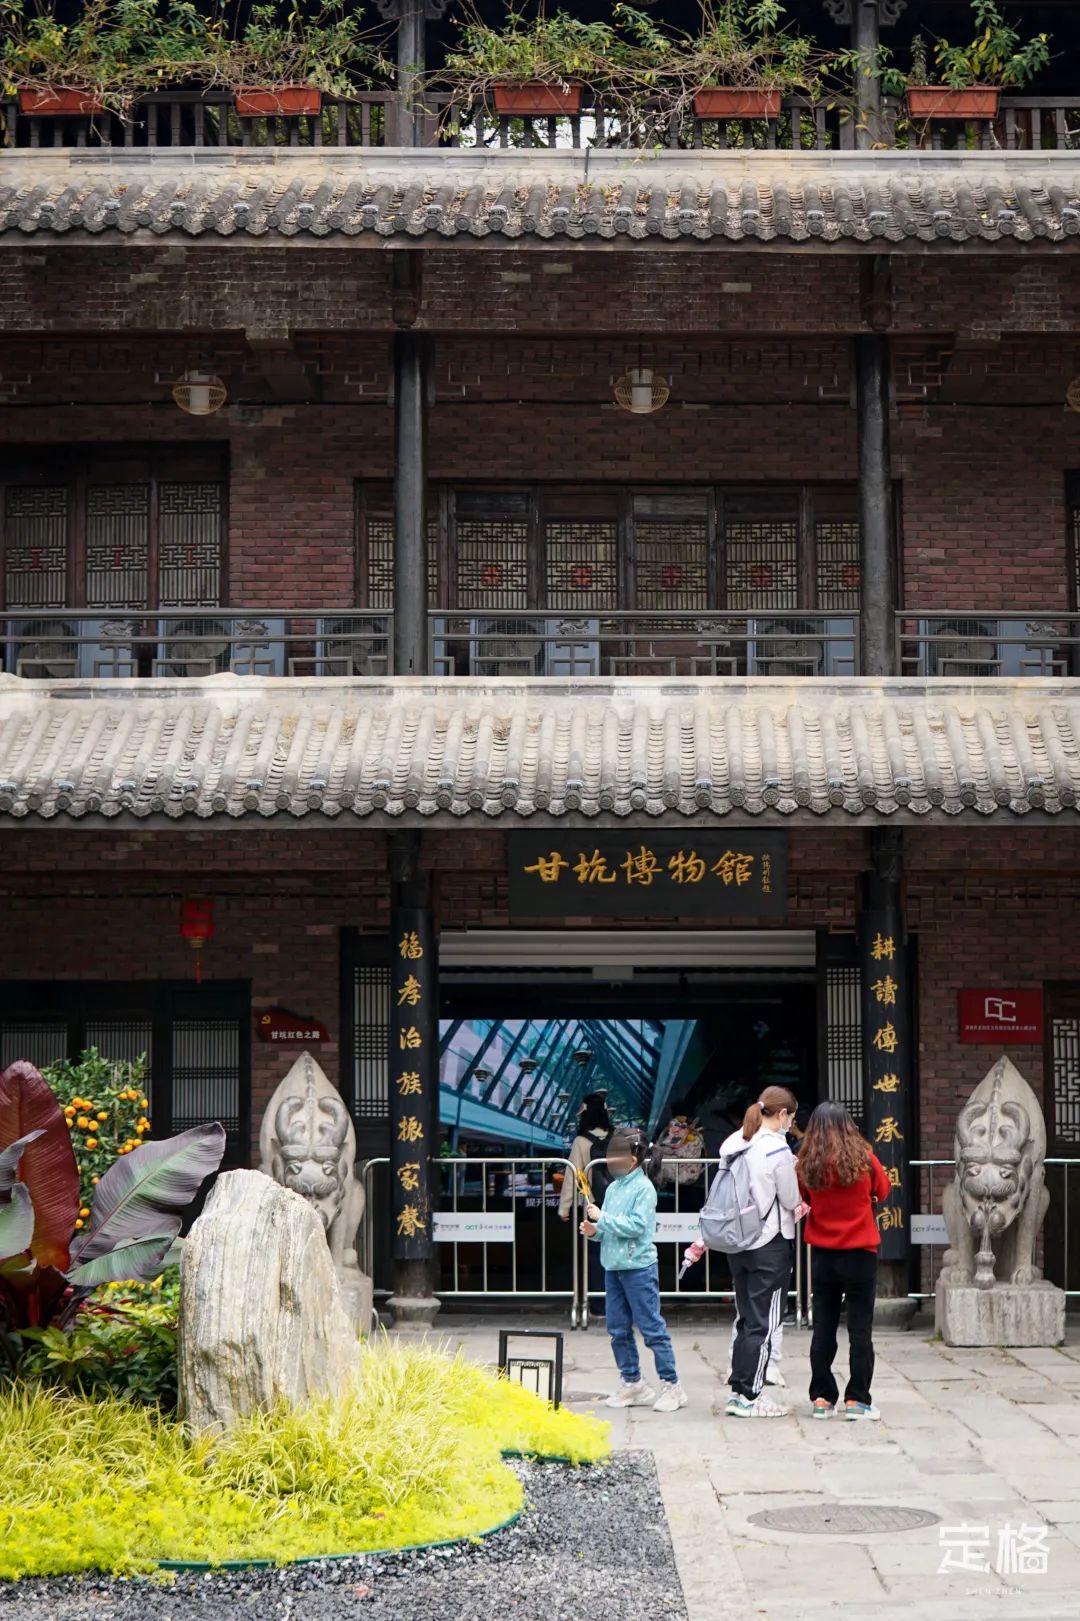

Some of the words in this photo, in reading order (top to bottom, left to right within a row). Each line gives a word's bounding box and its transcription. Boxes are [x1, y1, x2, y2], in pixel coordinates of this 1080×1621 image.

[524, 846, 754, 887] 甘坑博物館
